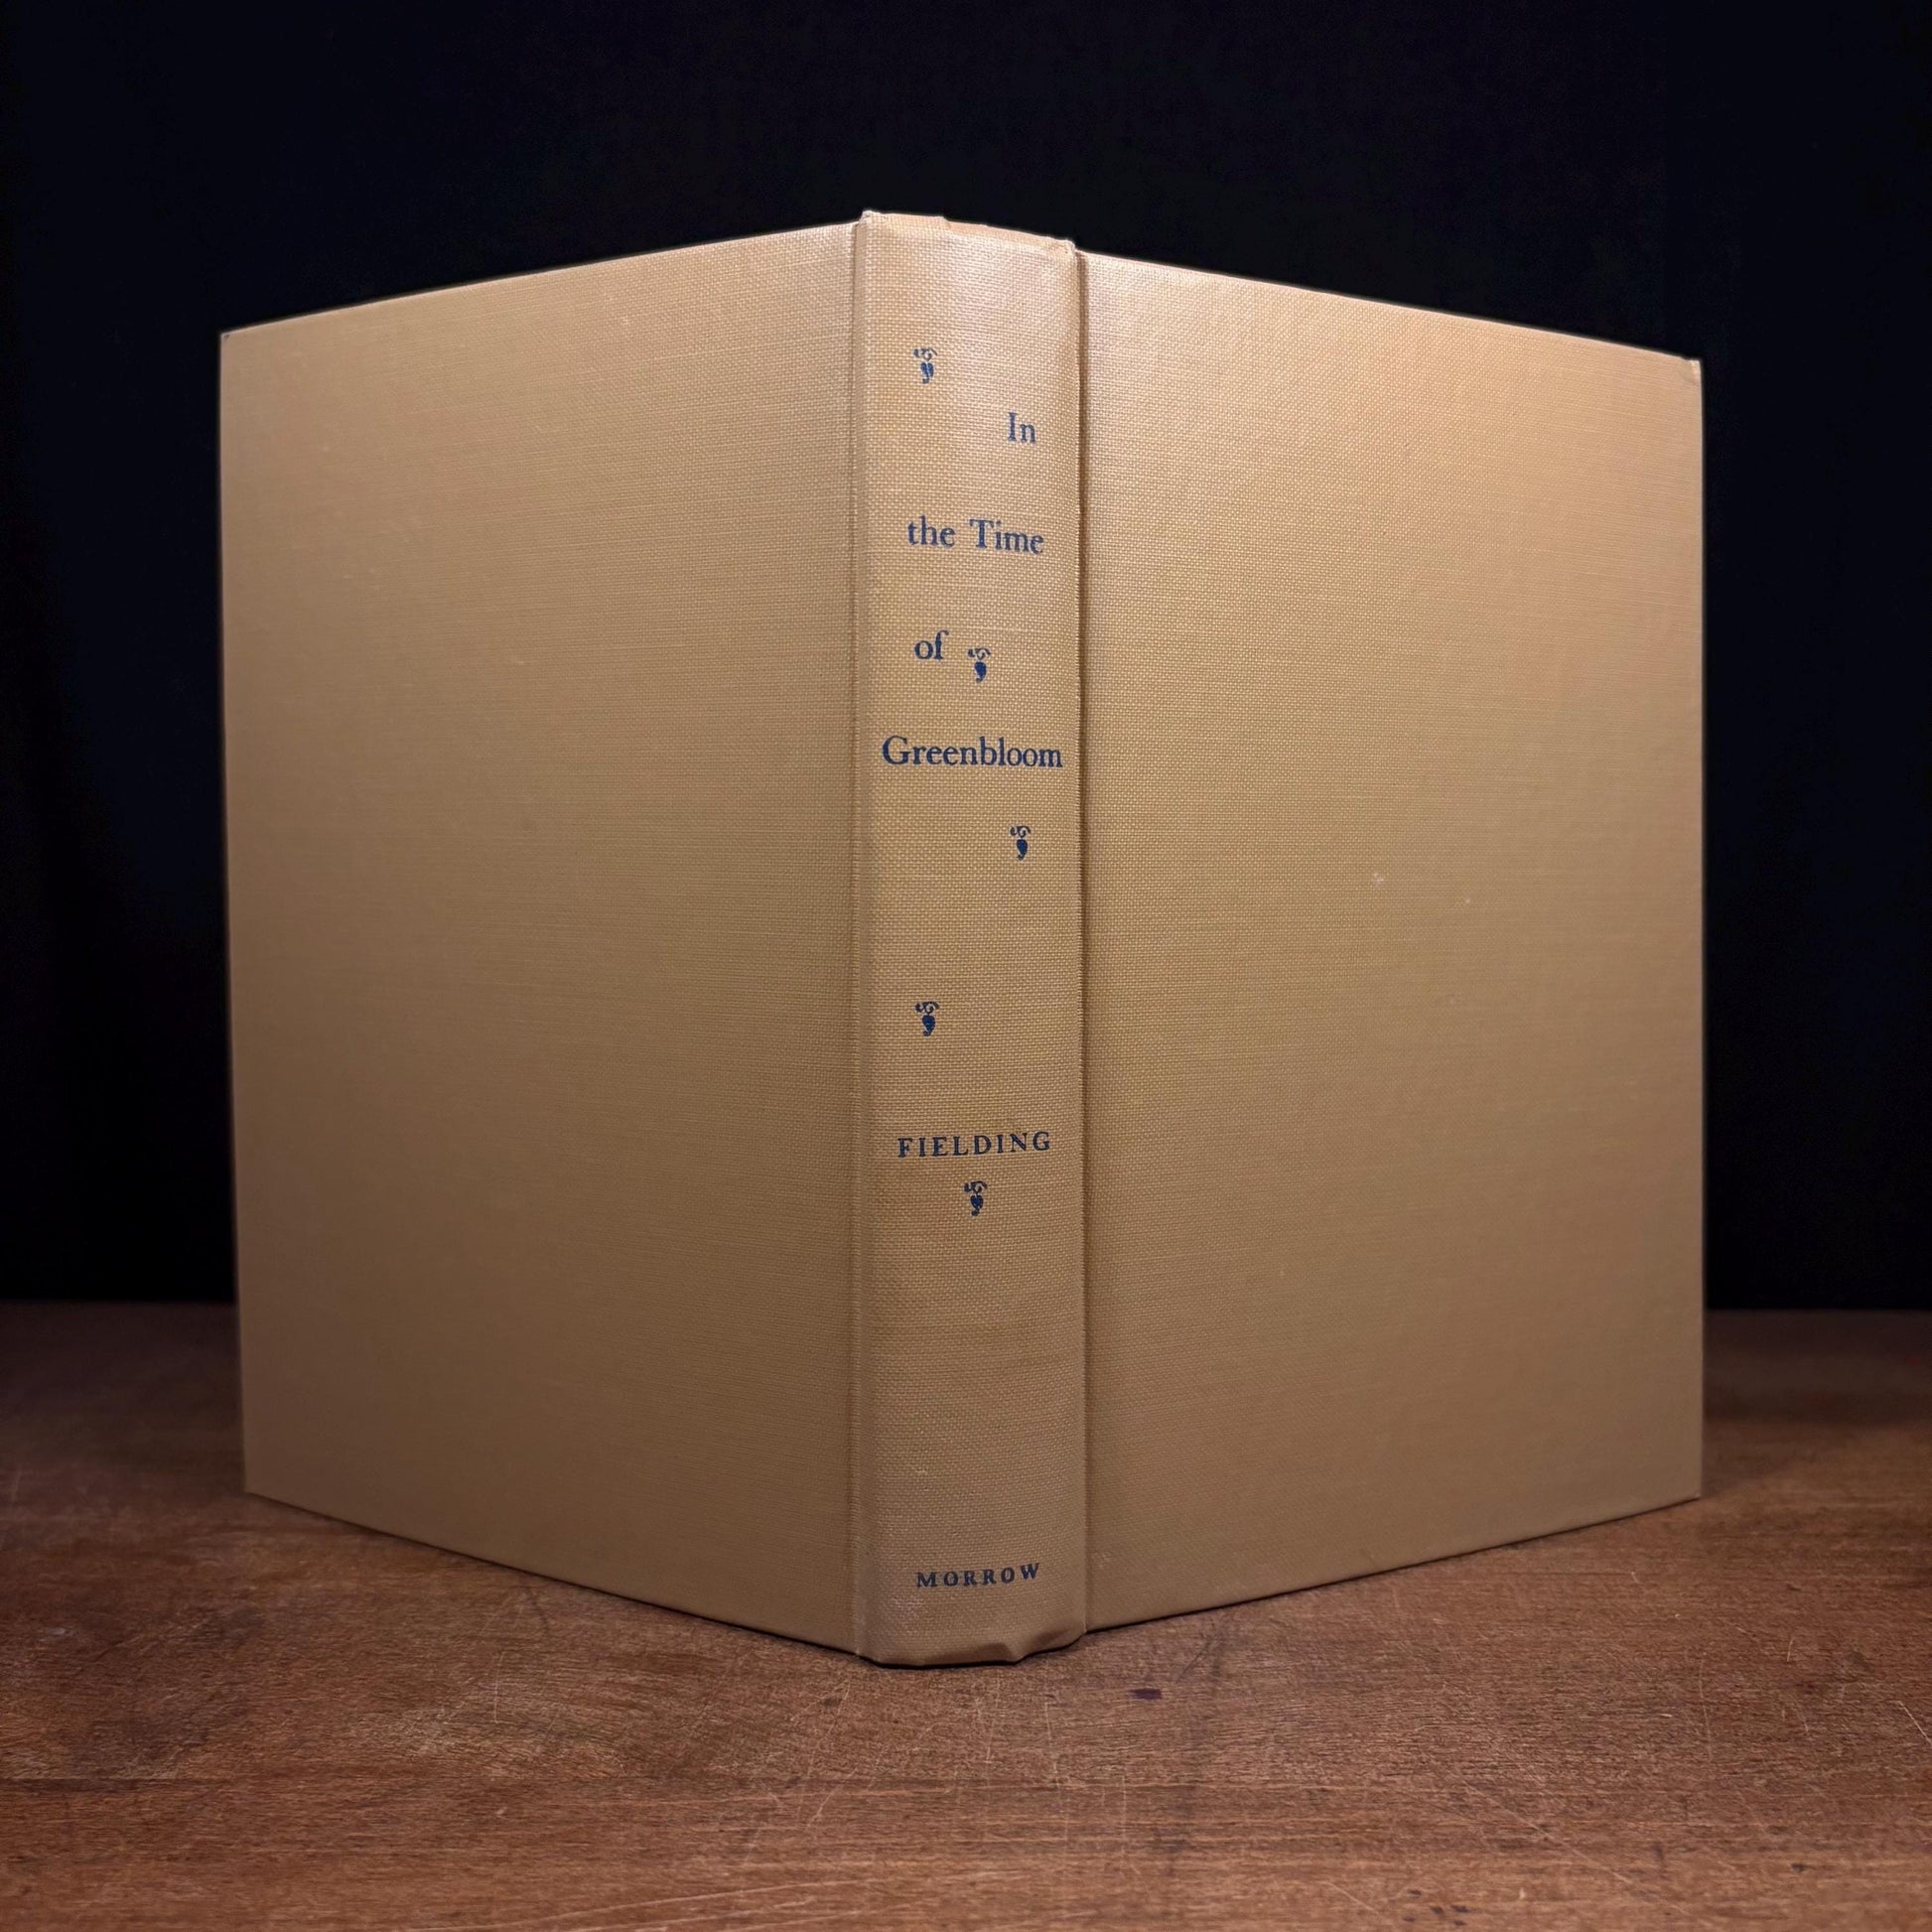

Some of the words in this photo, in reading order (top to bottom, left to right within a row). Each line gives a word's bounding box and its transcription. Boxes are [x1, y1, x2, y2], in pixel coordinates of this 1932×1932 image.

[1007, 412, 1036, 444] In
[907, 516, 955, 549] the
[969, 517, 1044, 554] Time
[913, 630, 949, 661] of
[881, 735, 1063, 768] Greenbloom
[897, 1130, 1052, 1158] FIELDING
[915, 1562, 1041, 1588] MORROW
